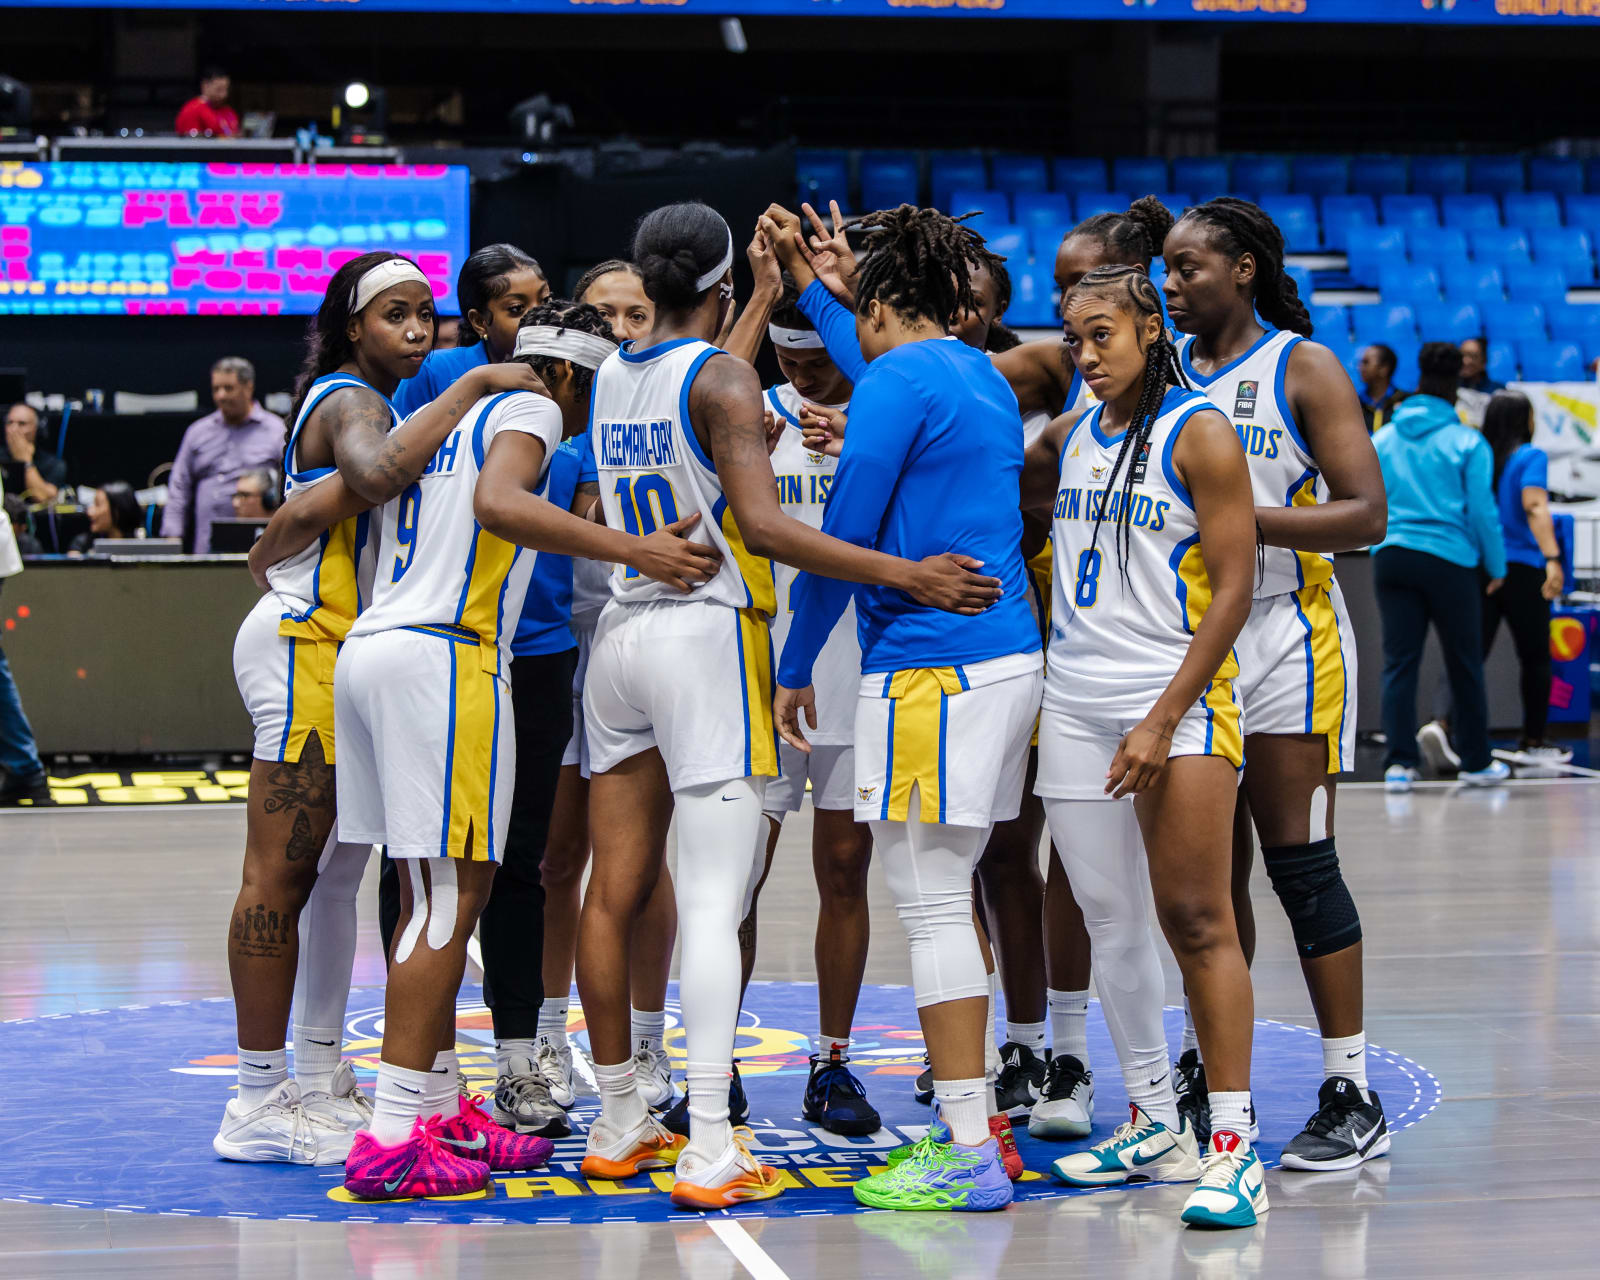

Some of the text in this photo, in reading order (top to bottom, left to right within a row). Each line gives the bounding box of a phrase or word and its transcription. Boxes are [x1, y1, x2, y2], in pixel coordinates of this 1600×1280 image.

[1237, 401, 1253, 409] FIBA
[775, 474, 804, 504] IN
[391, 481, 422, 585] 9
[614, 472, 681, 581] 10
[1075, 548, 1102, 609] 8
